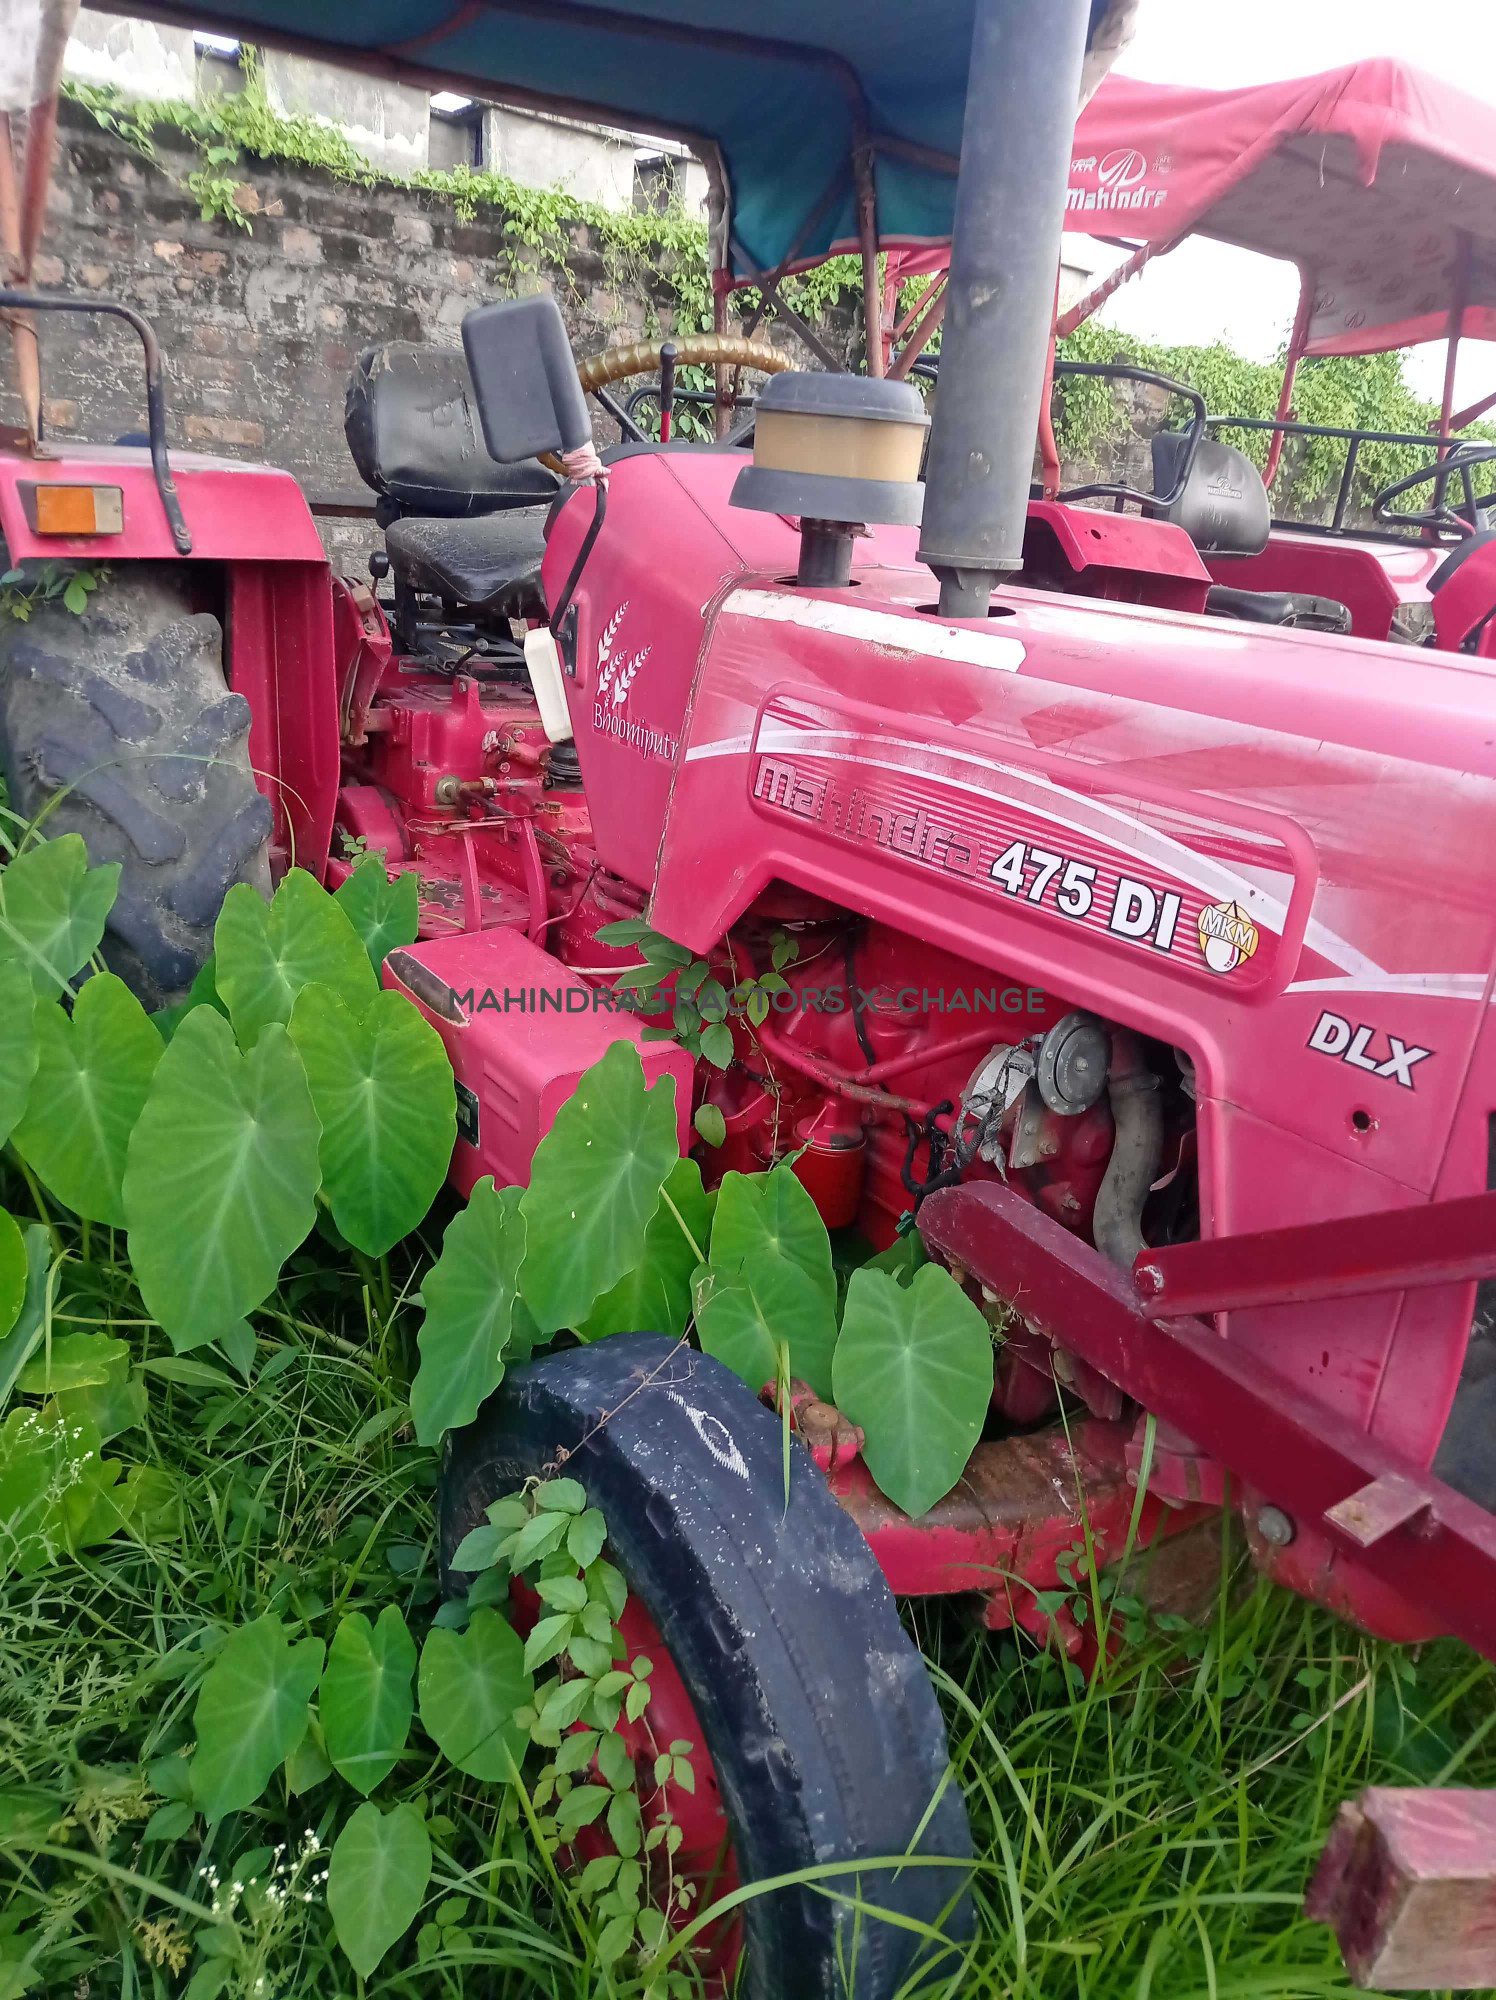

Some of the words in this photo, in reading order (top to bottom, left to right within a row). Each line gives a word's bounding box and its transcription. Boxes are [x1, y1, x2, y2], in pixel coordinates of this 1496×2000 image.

[594, 702, 679, 760] Bhoomiputr
[754, 756, 981, 877] Mahindra
[990, 841, 1098, 917] 475
[1109, 877, 1182, 953] DI
[1201, 906, 1256, 953] MKM
[1307, 1010, 1436, 1091] DLX
